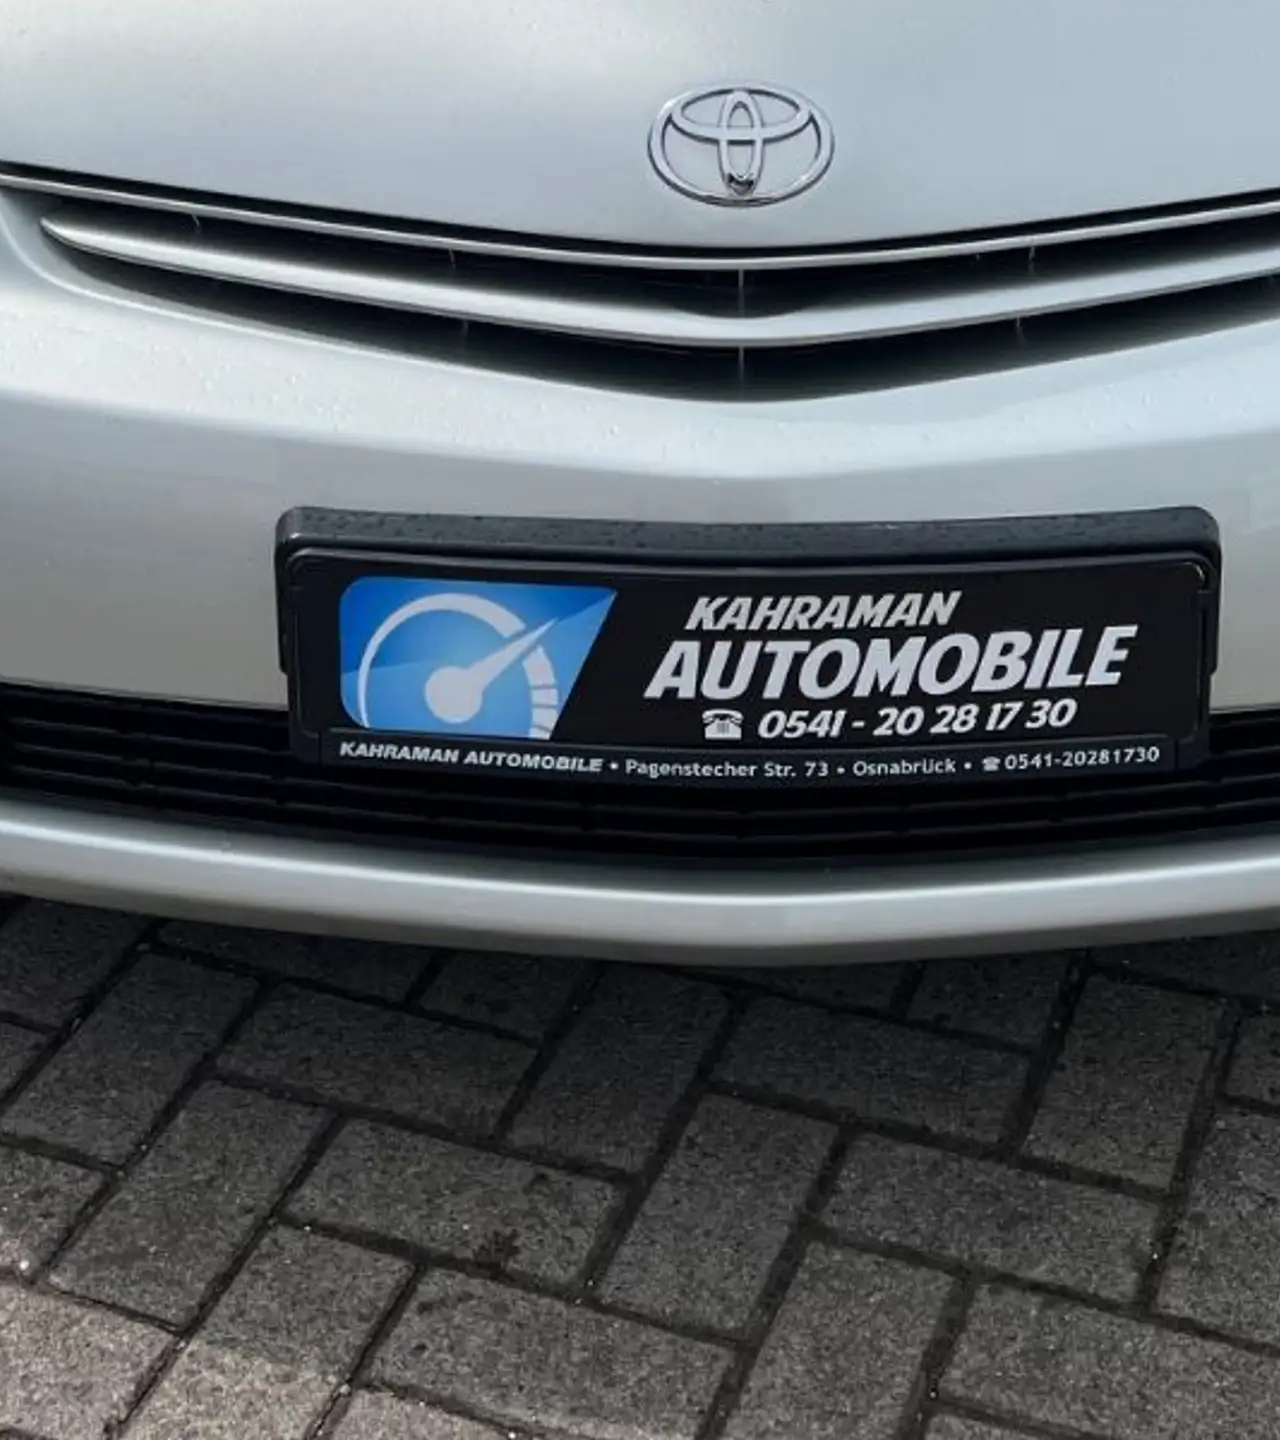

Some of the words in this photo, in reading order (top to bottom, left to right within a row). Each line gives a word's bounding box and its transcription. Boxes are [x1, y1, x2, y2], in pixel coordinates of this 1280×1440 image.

[684, 591, 962, 630] KAHRAMAN
[643, 624, 1138, 700] AUTOMOBILE
[757, 709, 847, 739] 0541
[872, 706, 924, 737] 20
[929, 703, 979, 734] 28
[985, 700, 1024, 731] 17
[1025, 698, 1078, 729] 30
[340, 741, 459, 764] KAHRAMAN
[464, 750, 603, 772] AUTOMOBILE
[625, 759, 758, 779] Pagenstecher
[763, 762, 797, 777] Str.
[805, 762, 829, 777] 73
[852, 758, 956, 776] Osnabrück
[1004, 746, 1160, 770] 0541-20281730
